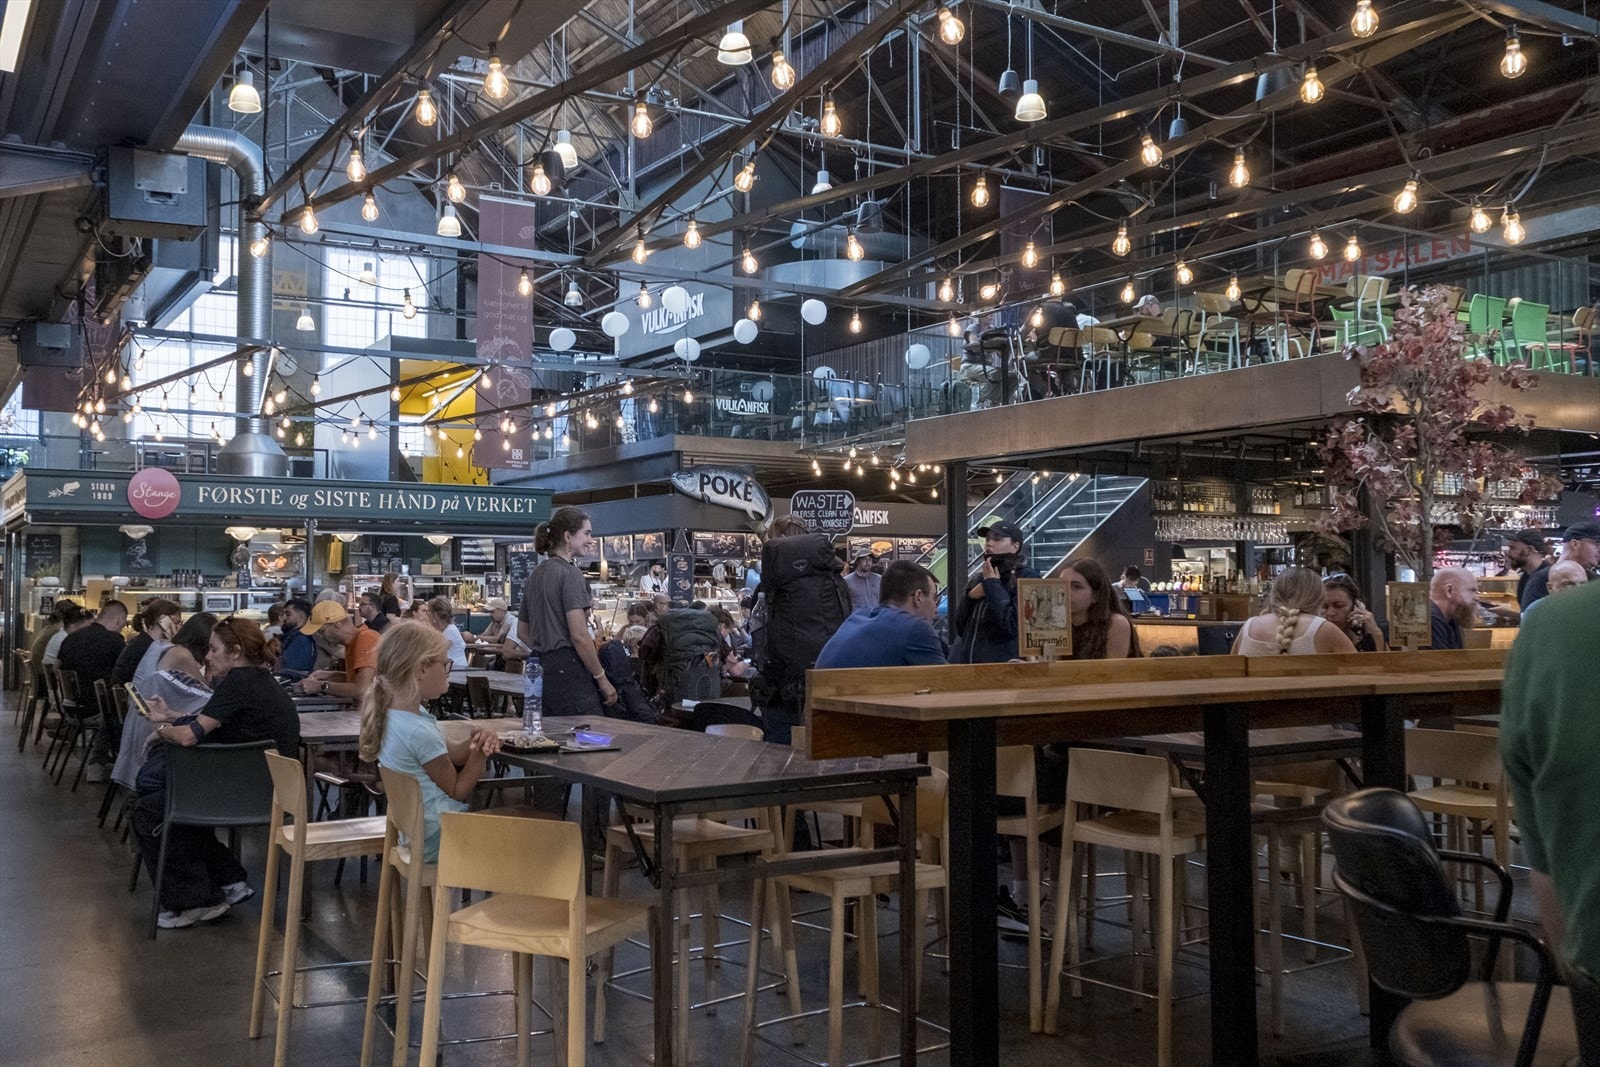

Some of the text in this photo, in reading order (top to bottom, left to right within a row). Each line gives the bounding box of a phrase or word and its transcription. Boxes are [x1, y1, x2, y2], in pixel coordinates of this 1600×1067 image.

[1316, 232, 1472, 285] MATSALEN
[483, 311, 499, 320] god
[516, 315, 528, 323] og
[715, 398, 770, 414] VULKANFISK
[90, 482, 116, 491] SIDEN
[132, 481, 177, 507] Stange
[700, 473, 753, 503] POKE
[198, 486, 537, 514] FØRSTE og SISTE HÅND på VERKET
[796, 494, 844, 510] WASTE
[792, 509, 816, 518] PLEASE
[817, 509, 838, 518] CLEAN
[854, 506, 889, 525] ANFISK
[820, 519, 850, 528] YOURSELF
